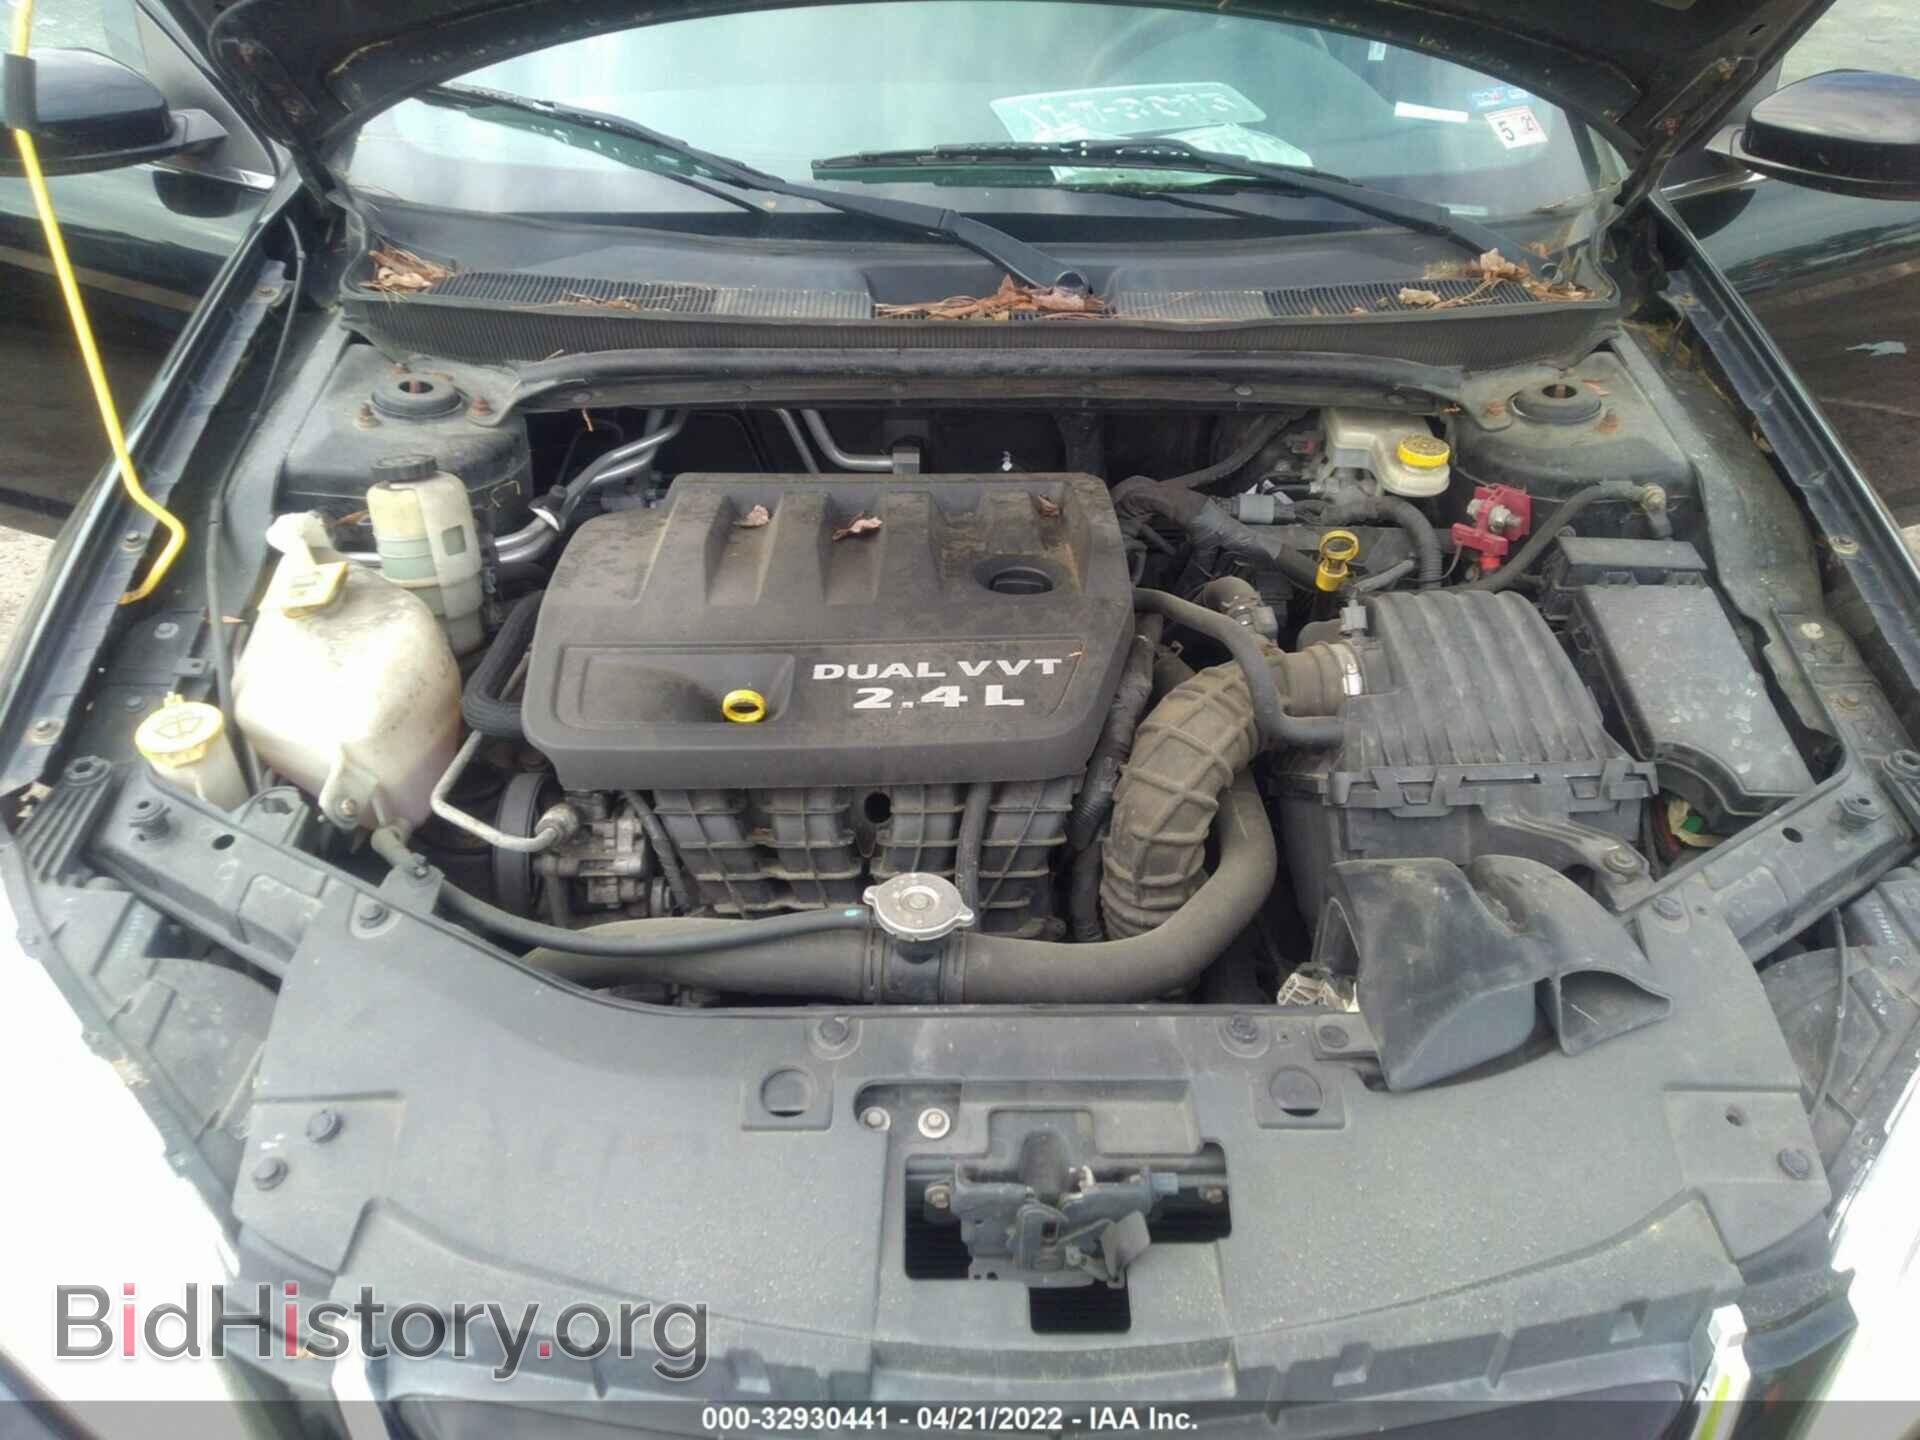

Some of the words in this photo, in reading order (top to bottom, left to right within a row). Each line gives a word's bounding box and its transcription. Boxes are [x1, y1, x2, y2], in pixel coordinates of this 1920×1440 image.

[812, 661, 947, 680] DUAL
[957, 658, 1063, 677] VVT
[852, 684, 969, 709] 2.4
[984, 684, 1025, 706] L
